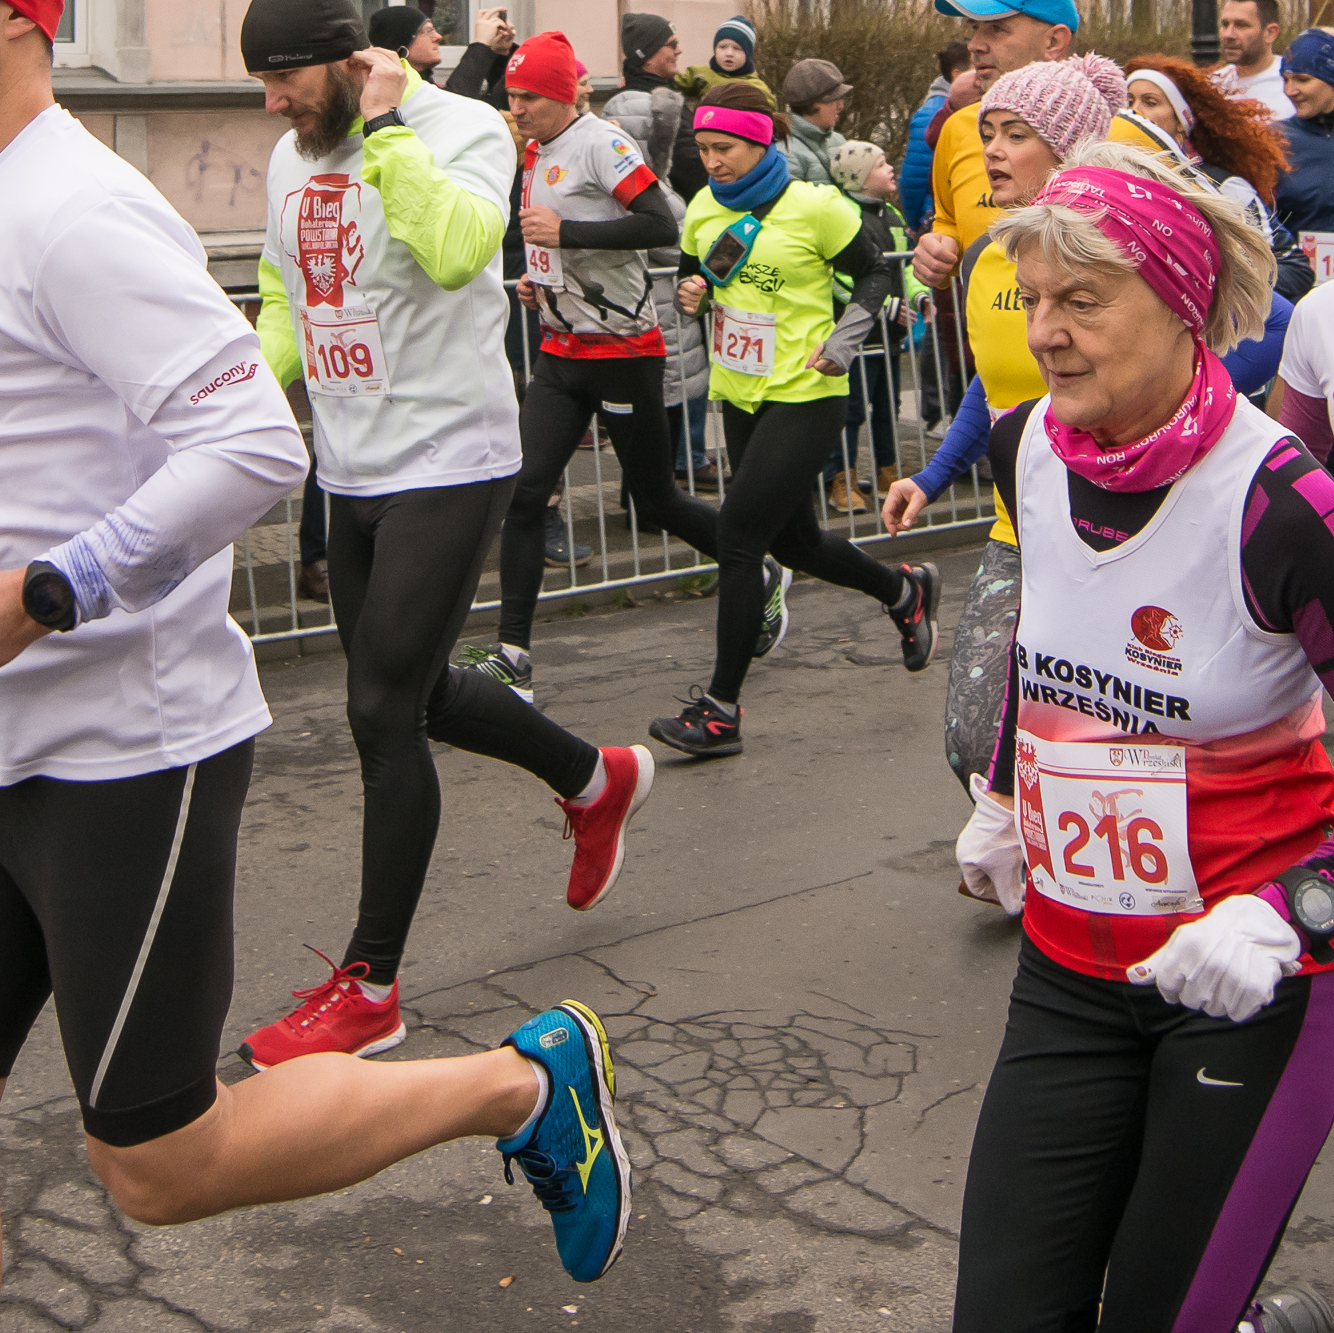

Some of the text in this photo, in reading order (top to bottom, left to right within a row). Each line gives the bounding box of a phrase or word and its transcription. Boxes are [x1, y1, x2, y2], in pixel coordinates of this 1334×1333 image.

[301, 196, 340, 227] V Bieg
[317, 342, 374, 380] 109
[726, 332, 764, 364] 271
[189, 361, 246, 406] saucony
[1124, 646, 1183, 672] KOSYNIER
[1020, 675, 1160, 734] WRZEŚNIA
[1035, 651, 1193, 722] KOSYNIER
[1058, 810, 1169, 885] 216
